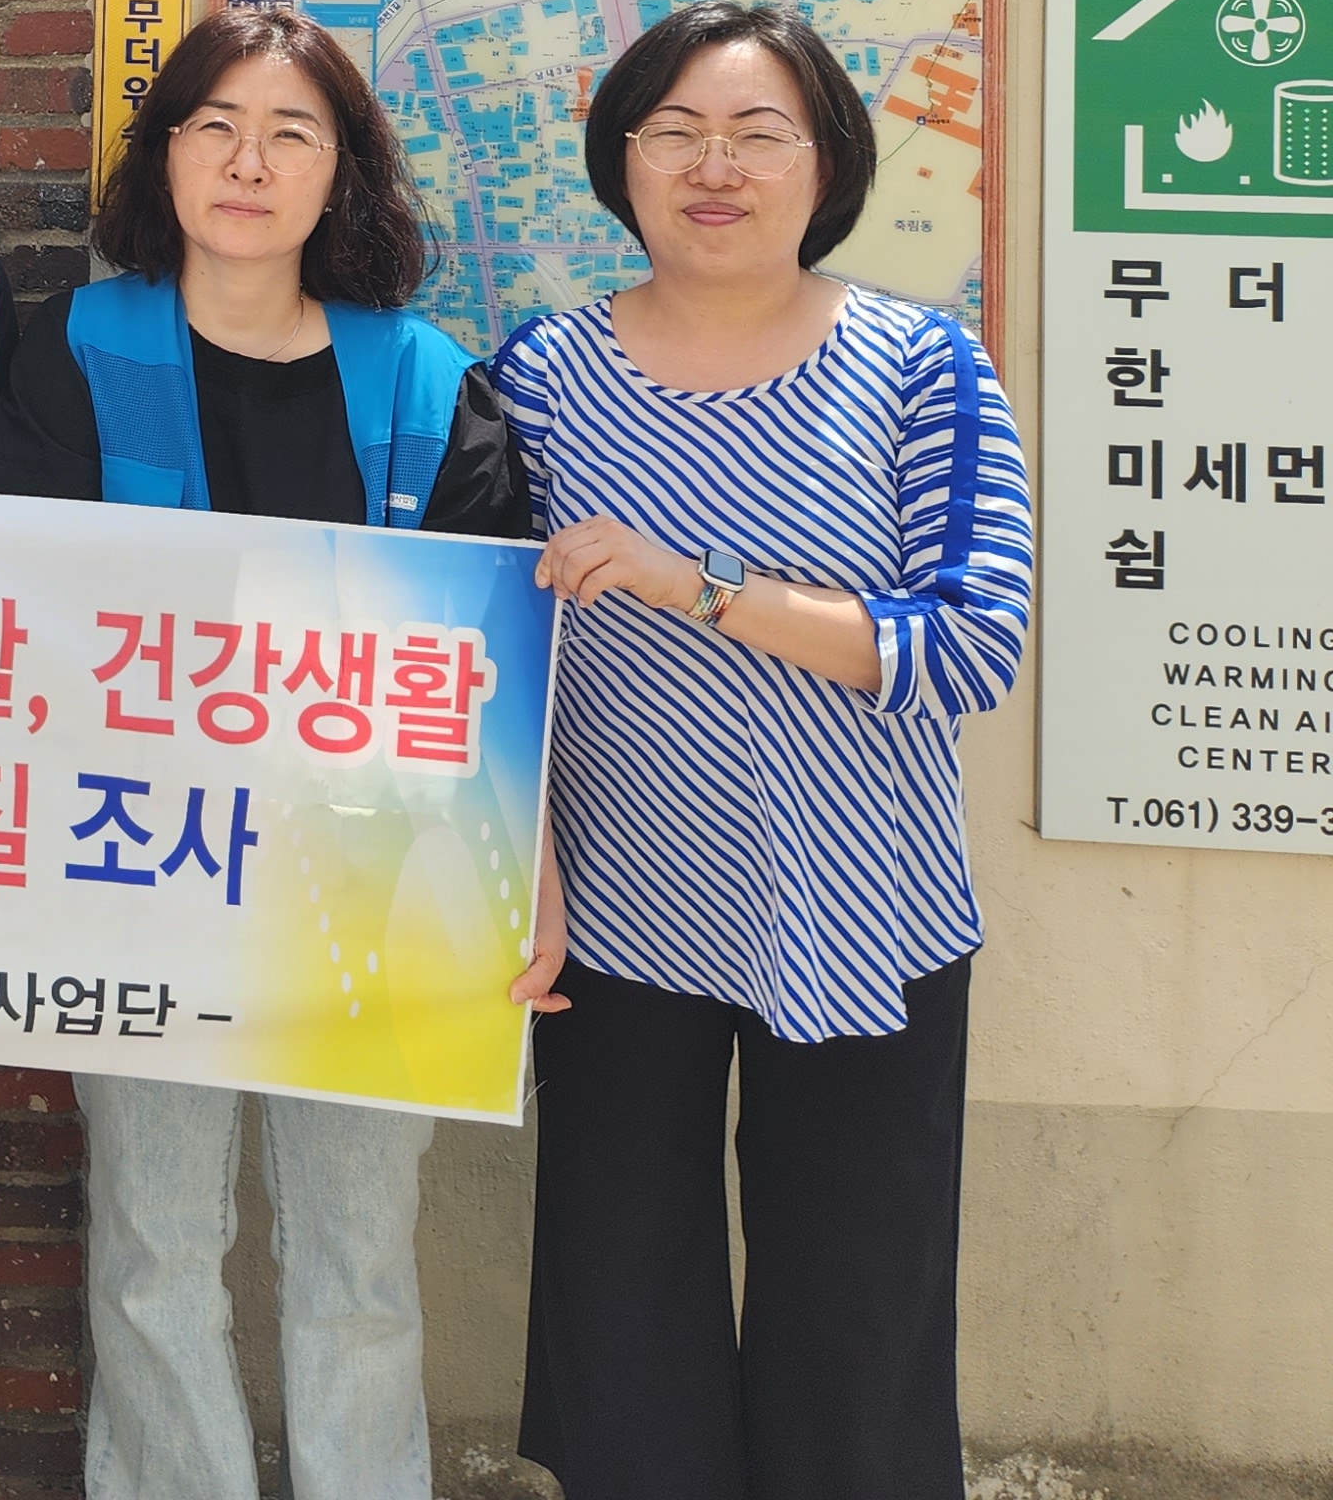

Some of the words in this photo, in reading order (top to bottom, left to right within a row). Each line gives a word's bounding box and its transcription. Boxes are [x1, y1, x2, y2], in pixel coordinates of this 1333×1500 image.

[894, 219, 933, 233] 죽림동
[1105, 347, 1170, 408] 한
[1108, 439, 1325, 505] 미세먼
[1105, 529, 1164, 590] 쉼
[92, 611, 485, 765] 건강생활
[1151, 703, 1279, 731] CLEAN
[1178, 746, 1332, 775] CENTER
[64, 772, 259, 906] 조사
[1107, 796, 1219, 833] T.061)
